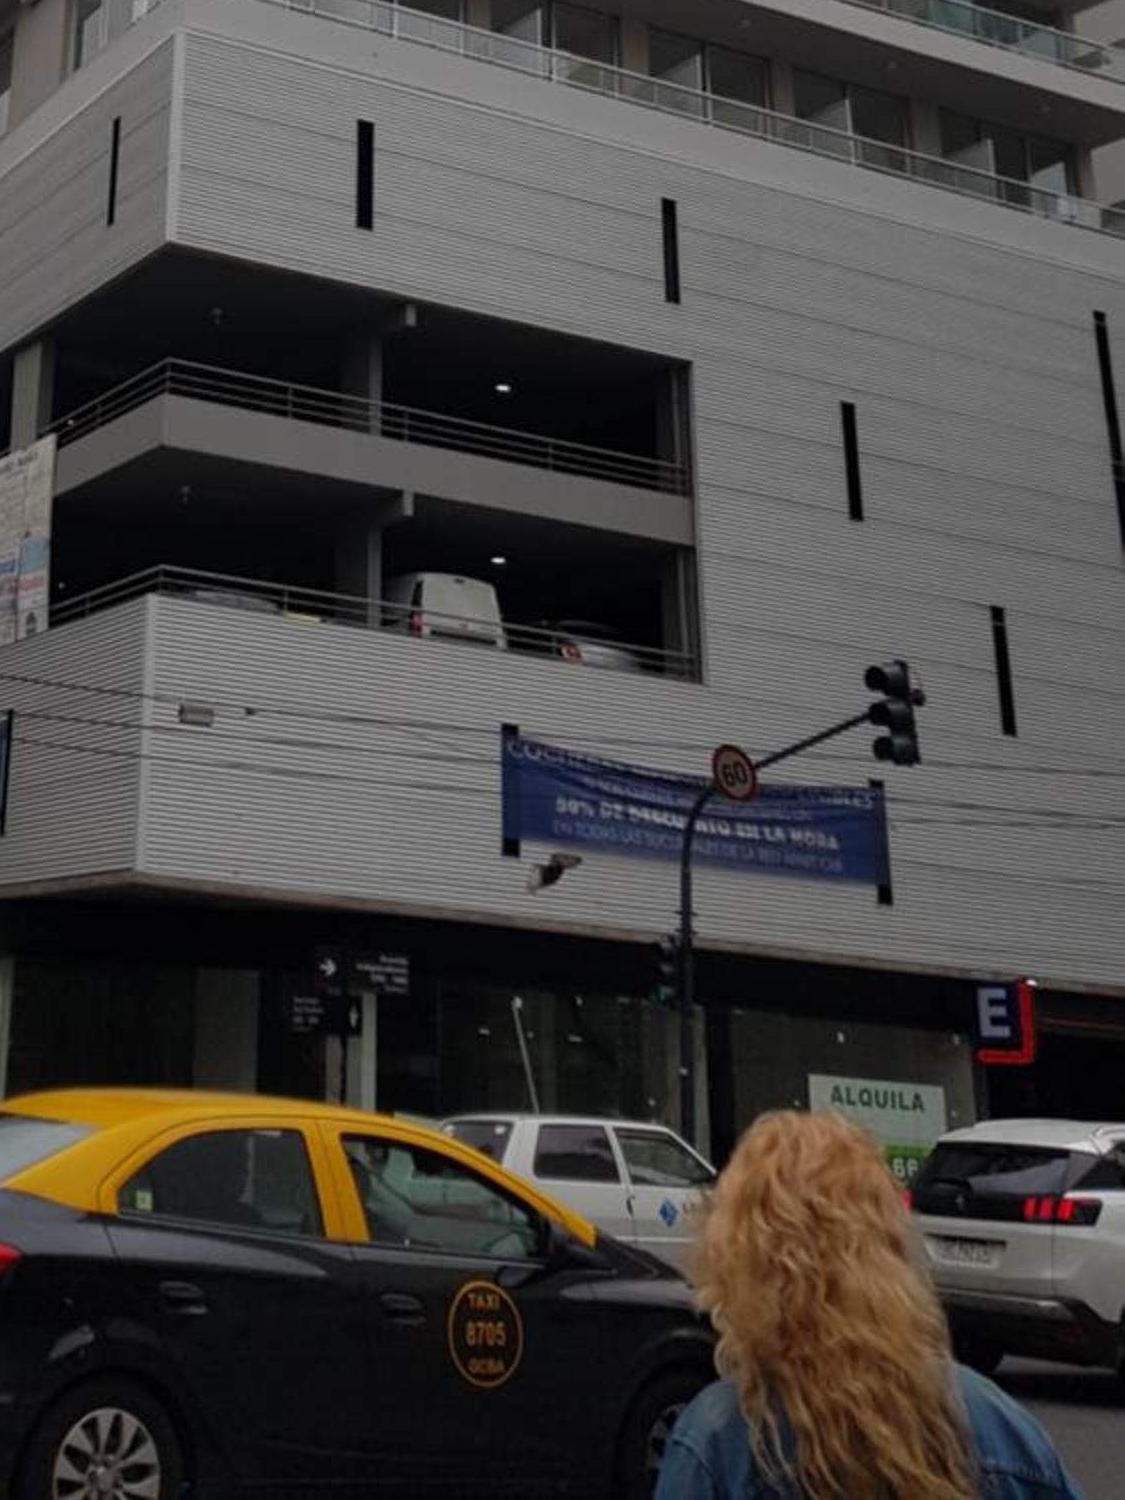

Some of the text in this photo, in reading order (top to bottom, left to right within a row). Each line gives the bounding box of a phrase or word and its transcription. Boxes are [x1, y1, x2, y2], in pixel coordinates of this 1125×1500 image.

[722, 762, 748, 787] 60
[629, 805, 731, 836] DESCUNTO
[976, 987, 1011, 1038] E
[830, 1084, 924, 1113] ALQUILA
[467, 1292, 501, 1311] TAXI
[465, 1320, 508, 1347] 8705
